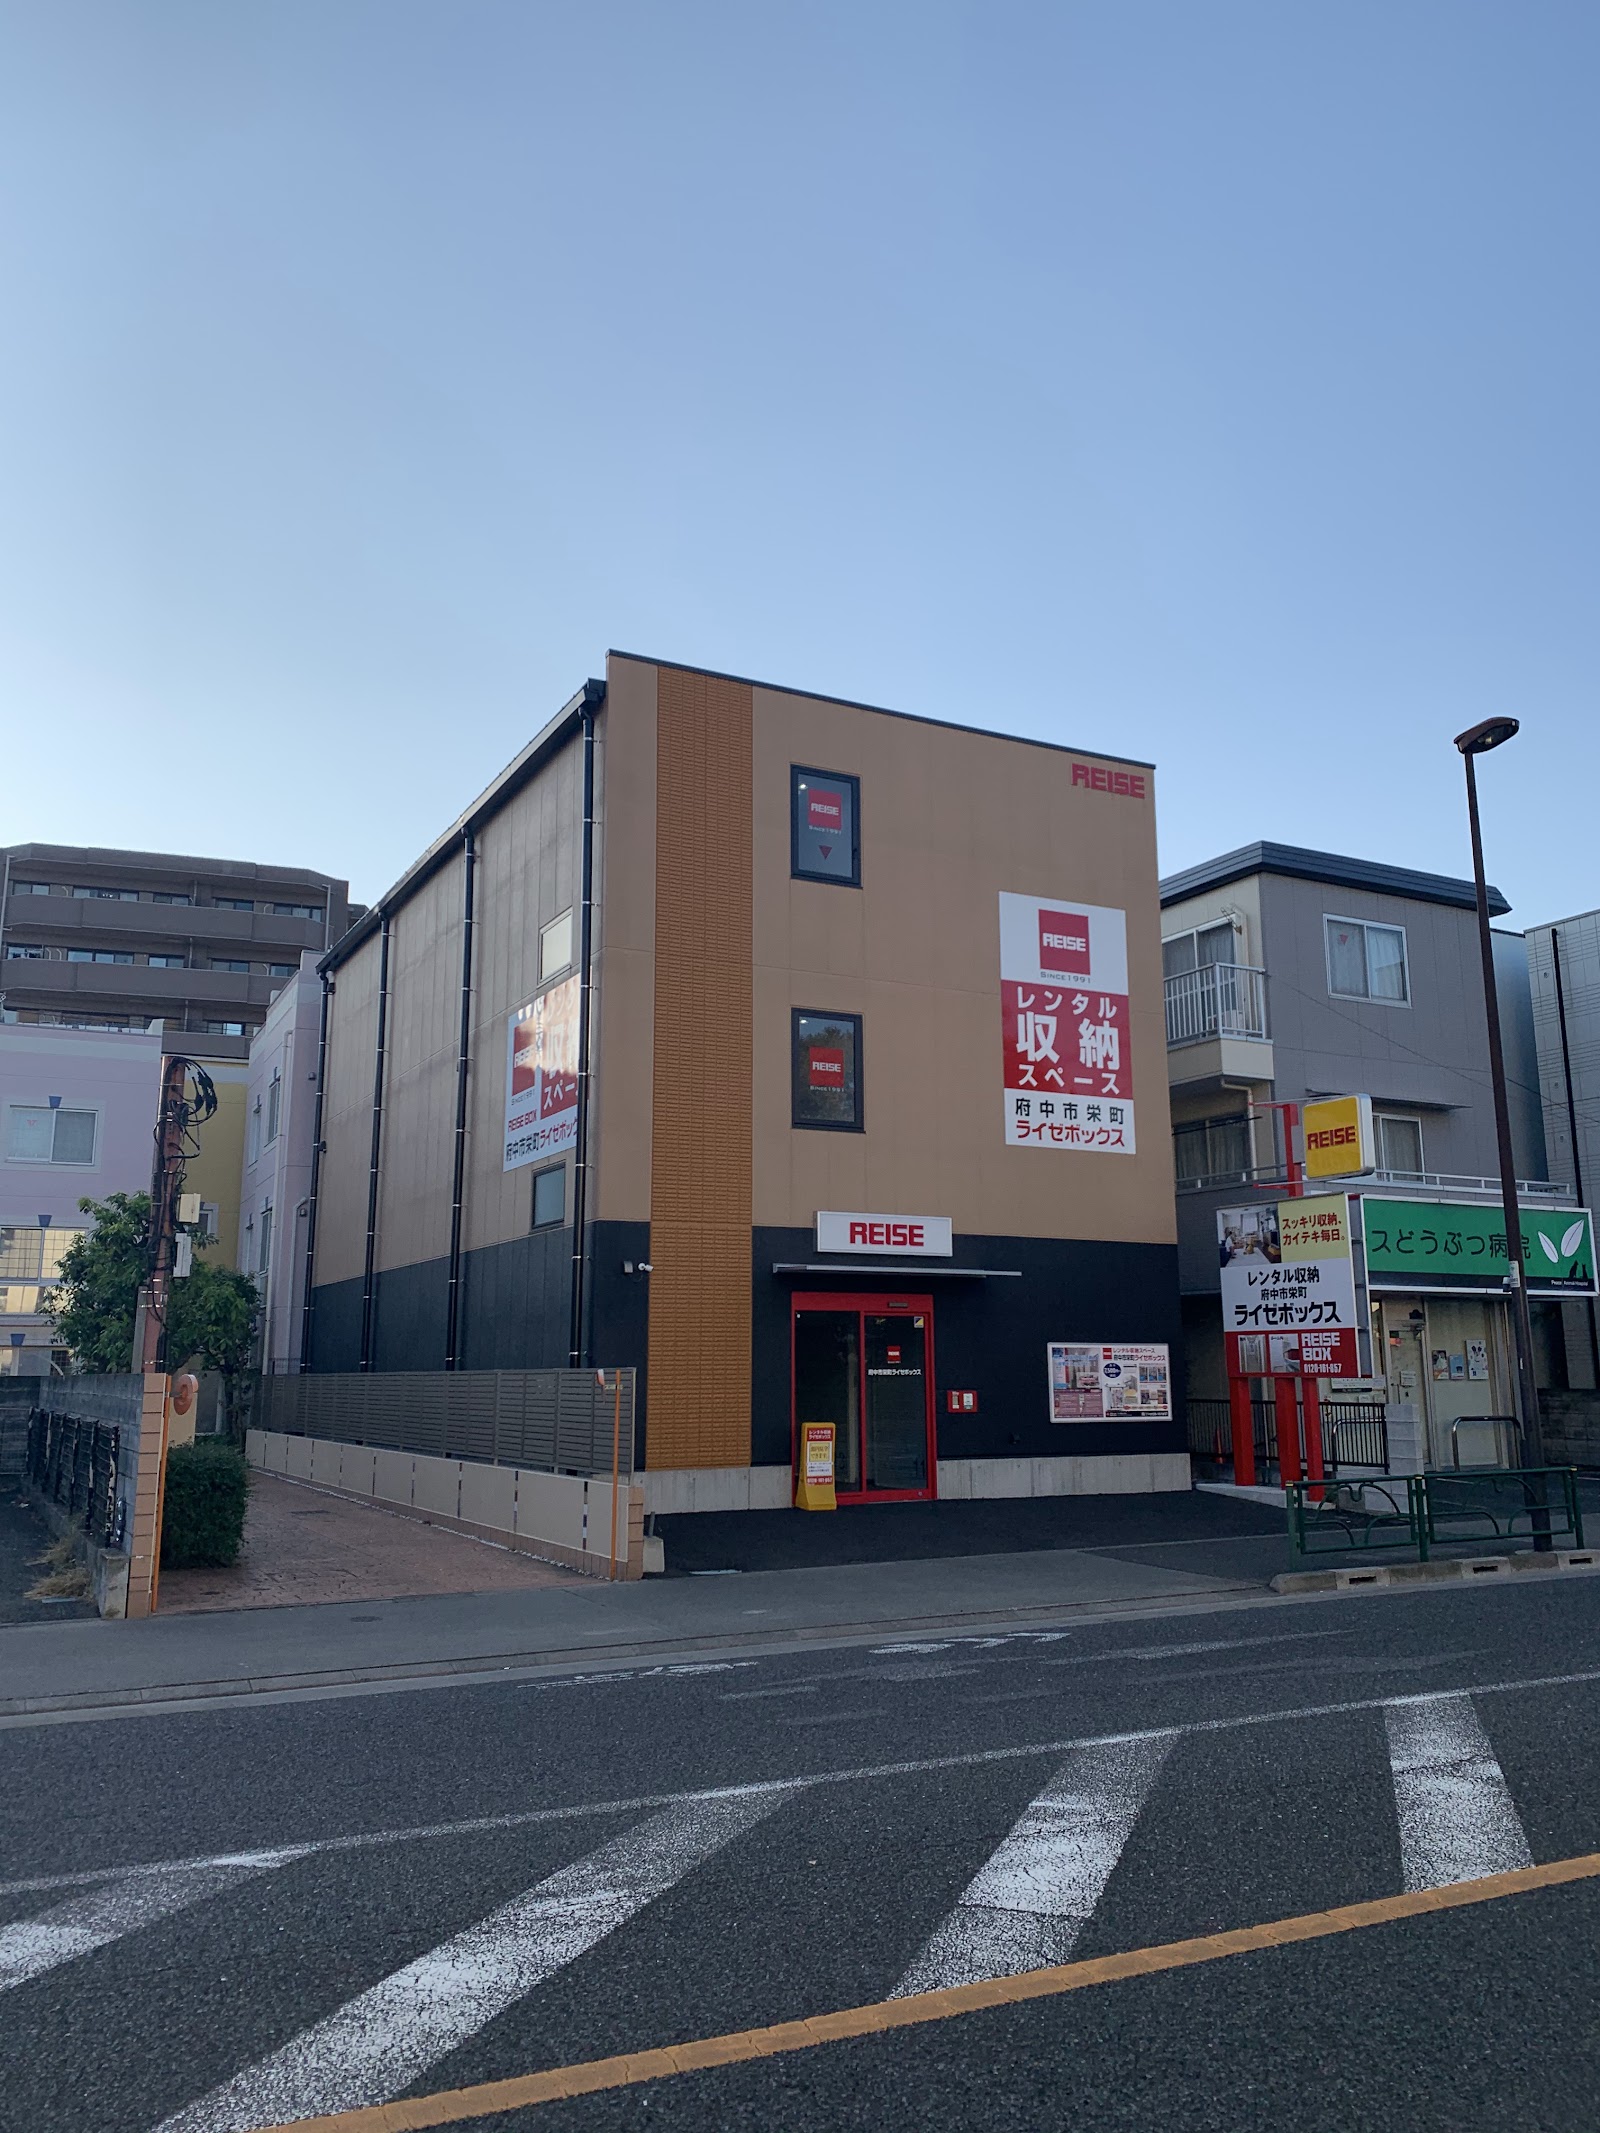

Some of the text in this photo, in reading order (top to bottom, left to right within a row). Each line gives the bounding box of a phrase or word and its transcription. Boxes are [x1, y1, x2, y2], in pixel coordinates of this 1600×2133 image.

[1072, 763, 1145, 798] REISE
[811, 802, 839, 816] REISE
[1042, 932, 1086, 951] REISE
[1017, 986, 1118, 1020] レンタル
[1016, 1011, 1120, 1071] 収納
[812, 1061, 841, 1074] REISE
[1018, 1063, 1120, 1096] スペース
[543, 1079, 578, 1111] スペー
[508, 1109, 537, 1133] REISE BOX
[1015, 1097, 1124, 1126] 府中市栄町
[1015, 1119, 1126, 1147] ライゼボックス
[1306, 1125, 1357, 1150] REISE
[1282, 1212, 1342, 1230] スッキリ収納、
[849, 1222, 924, 1247] REISE
[1283, 1229, 1346, 1246] カイテキ毎日。
[1248, 1266, 1320, 1286] レンタル収納
[1261, 1286, 1308, 1301] 府中市栄町
[1234, 1301, 1342, 1326] ライゼボックス
[1301, 1332, 1341, 1347] REISE
[1302, 1348, 1332, 1362] BOX
